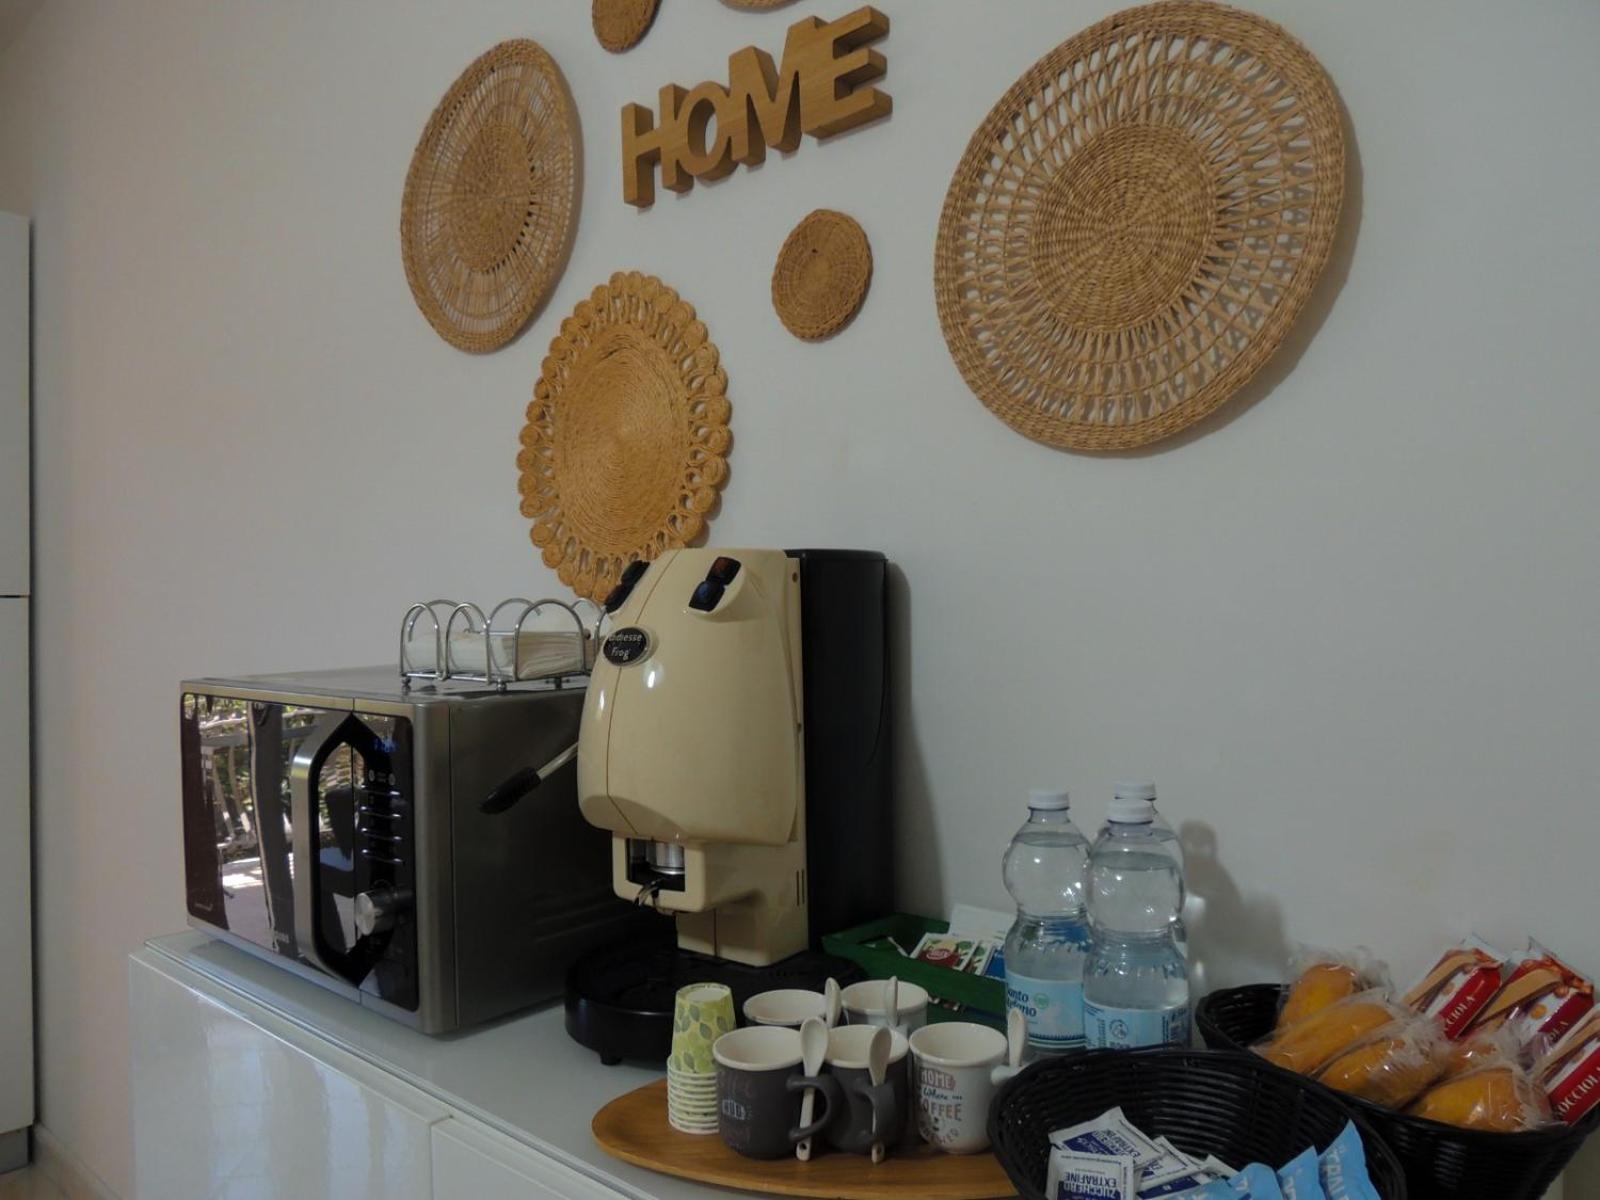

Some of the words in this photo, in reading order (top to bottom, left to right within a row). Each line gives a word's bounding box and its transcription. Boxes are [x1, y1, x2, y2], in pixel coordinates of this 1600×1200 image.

[621, 5, 893, 208] HOME
[611, 647, 629, 661] Frog
[1557, 1066, 1600, 1117] OCCIOL
[921, 1097, 962, 1122] OFFEE
[1063, 1181, 1117, 1199] ZUCCHERO
[1064, 1171, 1117, 1188] EXTRAFINE
